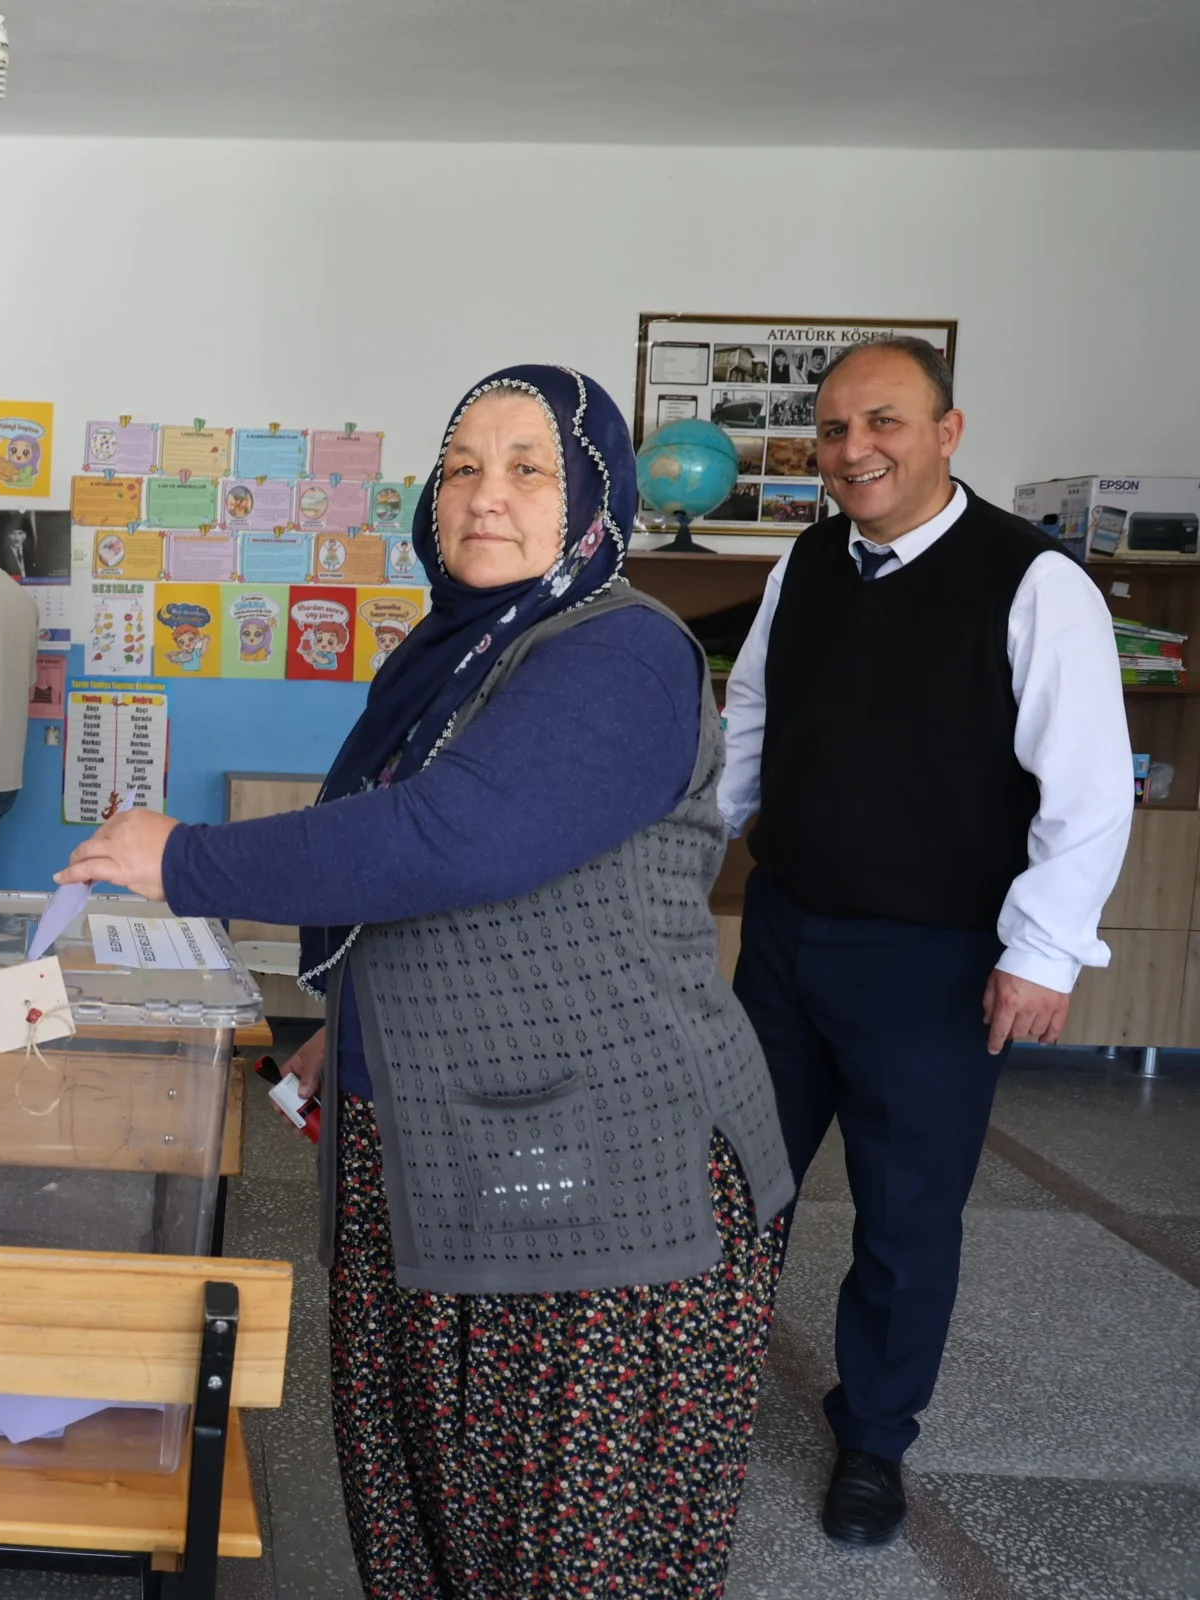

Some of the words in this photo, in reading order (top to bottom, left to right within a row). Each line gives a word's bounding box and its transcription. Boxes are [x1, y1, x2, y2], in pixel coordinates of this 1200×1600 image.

[768, 326, 836, 341] ATATÜRK
[1100, 480, 1139, 490] EPSON
[1019, 488, 1035, 496] EPSON
[82, 695, 102, 703] Yanlış
[132, 696, 153, 704] Doğru
